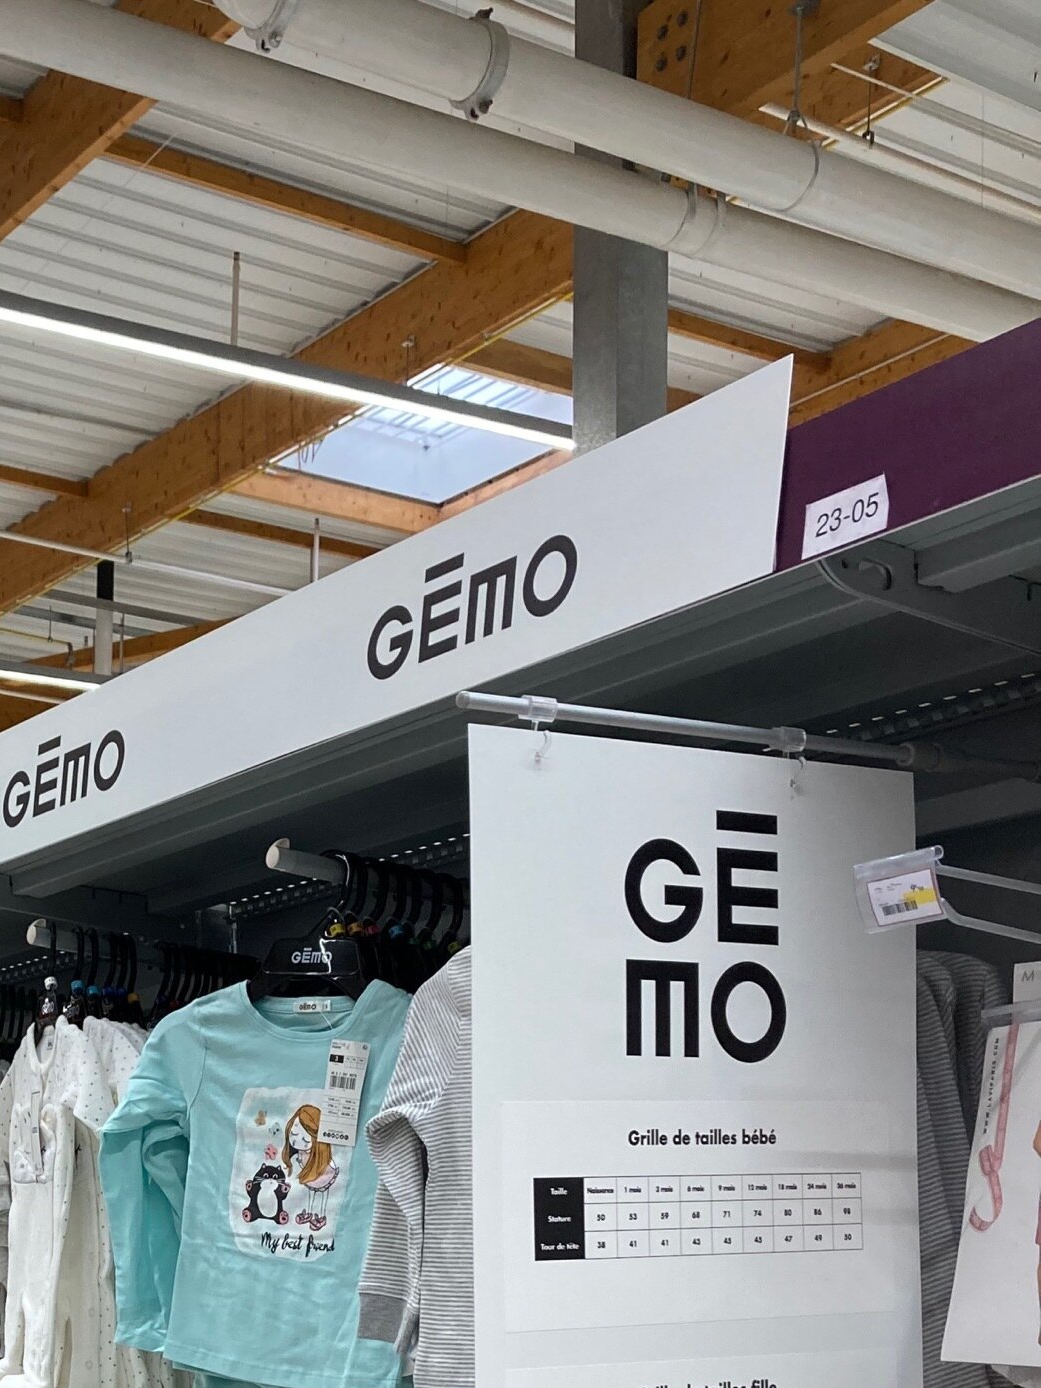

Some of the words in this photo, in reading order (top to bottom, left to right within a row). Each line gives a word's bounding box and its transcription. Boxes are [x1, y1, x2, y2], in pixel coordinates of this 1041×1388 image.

[815, 493, 879, 537] 23-05
[628, 1129, 668, 1146] Grille
[673, 1129, 691, 1145] de
[695, 1129, 737, 1145] tailles
[742, 1128, 776, 1145] bébé
[550, 1187, 568, 1195] Taille
[261, 1231, 279, 1254] My
[305, 1234, 335, 1258] friend
